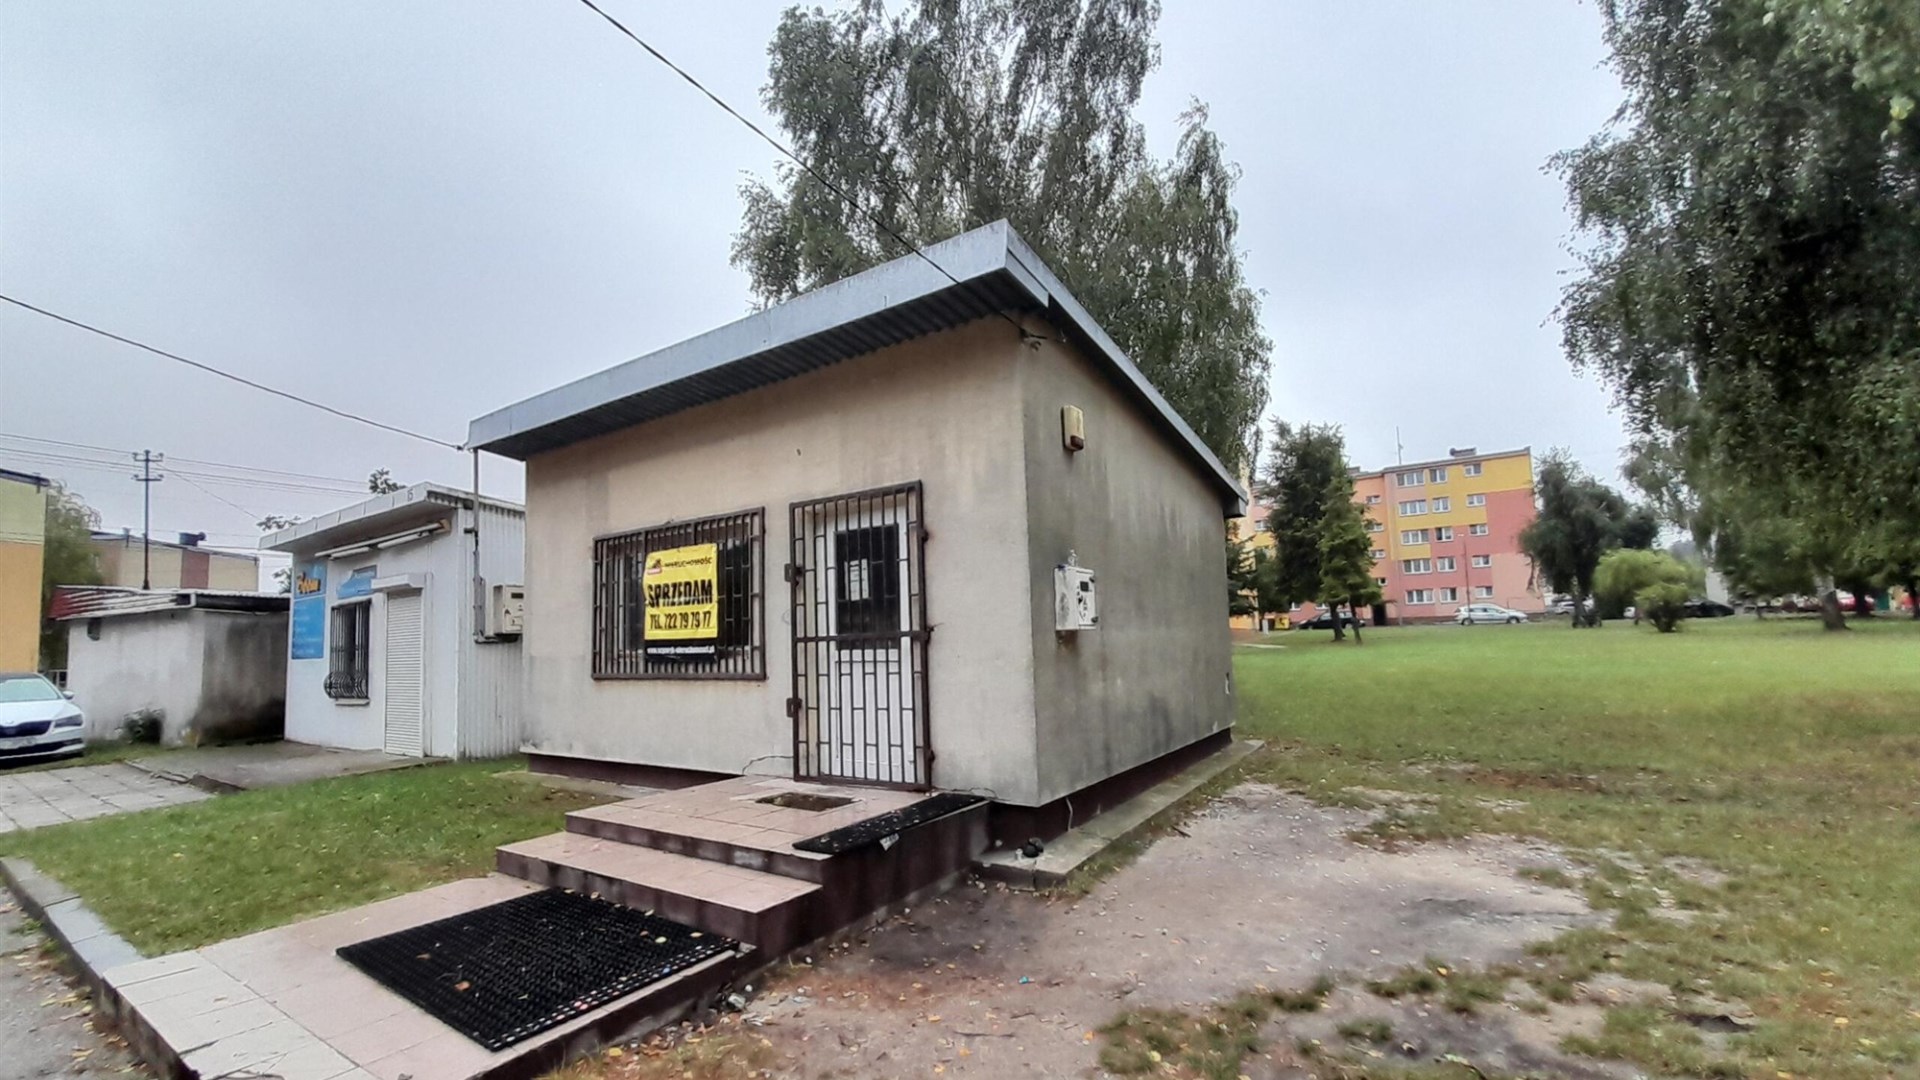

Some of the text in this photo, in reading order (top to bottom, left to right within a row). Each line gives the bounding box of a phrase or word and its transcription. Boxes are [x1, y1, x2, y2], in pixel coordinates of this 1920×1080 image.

[647, 579, 713, 608] SPRZEDAM
[664, 612, 678, 629] 722
[679, 612, 689, 629] 79
